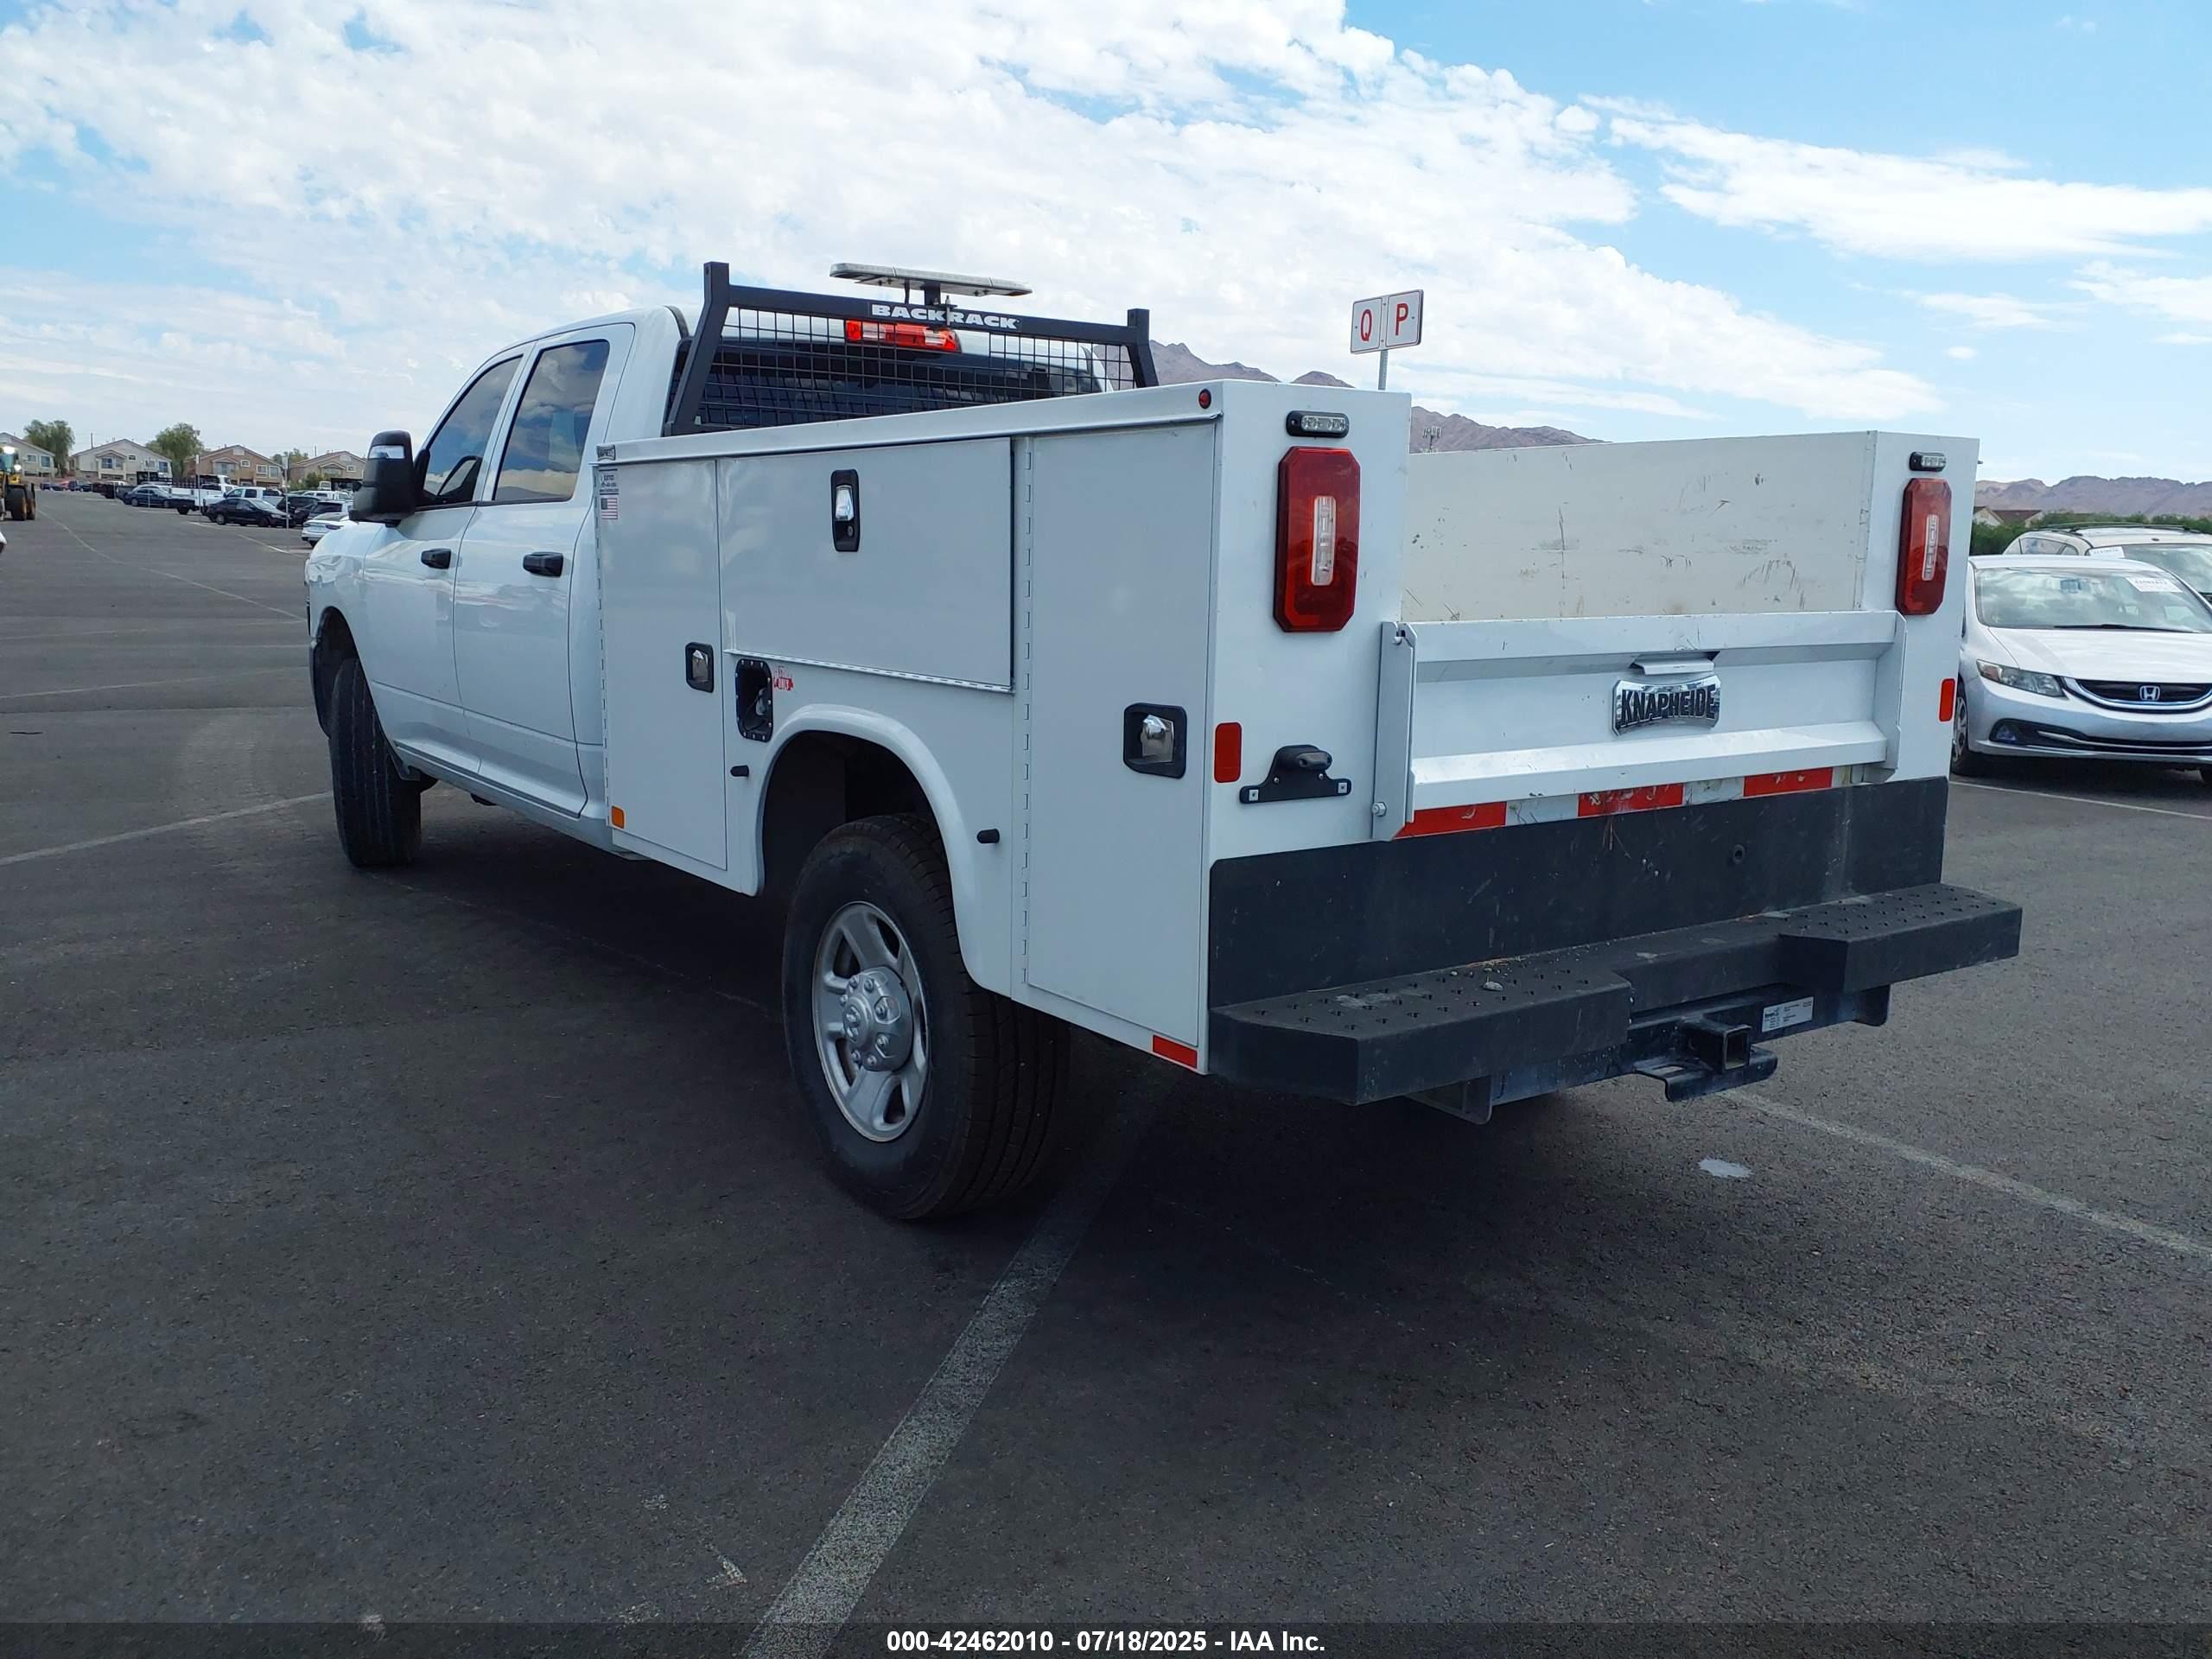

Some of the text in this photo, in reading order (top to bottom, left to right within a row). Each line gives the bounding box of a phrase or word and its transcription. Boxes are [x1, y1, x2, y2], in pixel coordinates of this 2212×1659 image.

[871, 303, 1018, 330] BACKRACK
[1360, 302, 1409, 342] Q P
[1619, 683, 1718, 723] KNAPHEIDE
